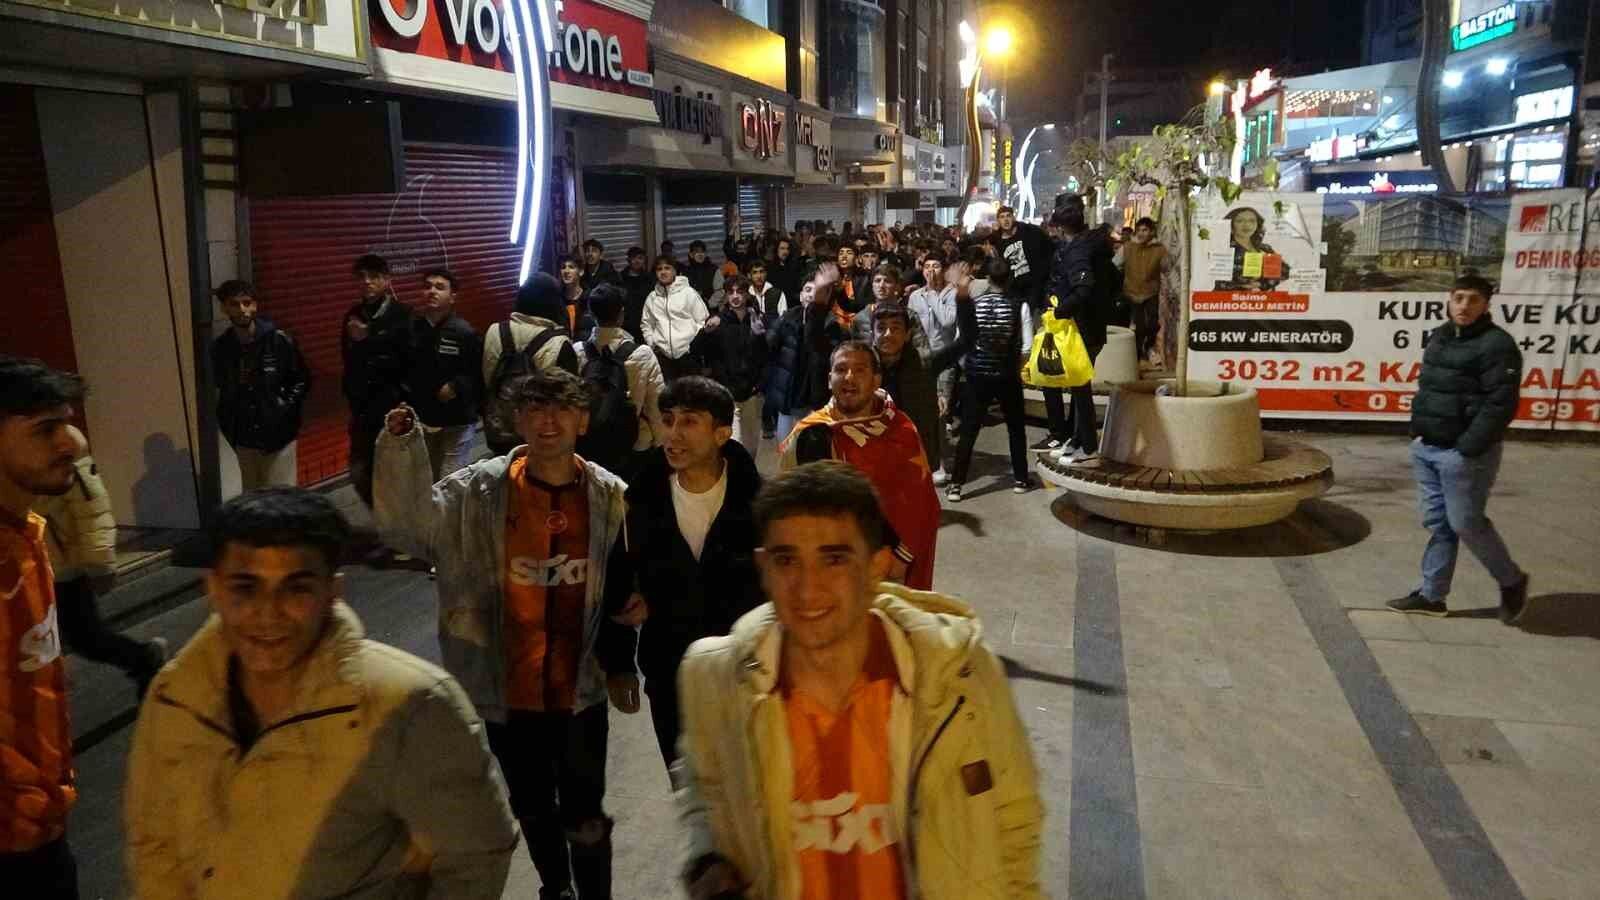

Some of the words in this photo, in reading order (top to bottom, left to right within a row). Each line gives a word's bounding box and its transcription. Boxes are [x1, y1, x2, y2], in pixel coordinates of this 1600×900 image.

[440, 0, 624, 81] vofone
[1193, 301, 1264, 311] DEMİROĞLU
[1266, 302, 1306, 311] METİN
[1501, 304, 1543, 324] VE
[1190, 331, 1217, 343] 165
[1221, 331, 1247, 343] KW
[1250, 330, 1343, 344] JENERATÖR
[1393, 329, 1410, 349] 6
[1217, 359, 1301, 381] 3032
[1312, 360, 1366, 382] m2
